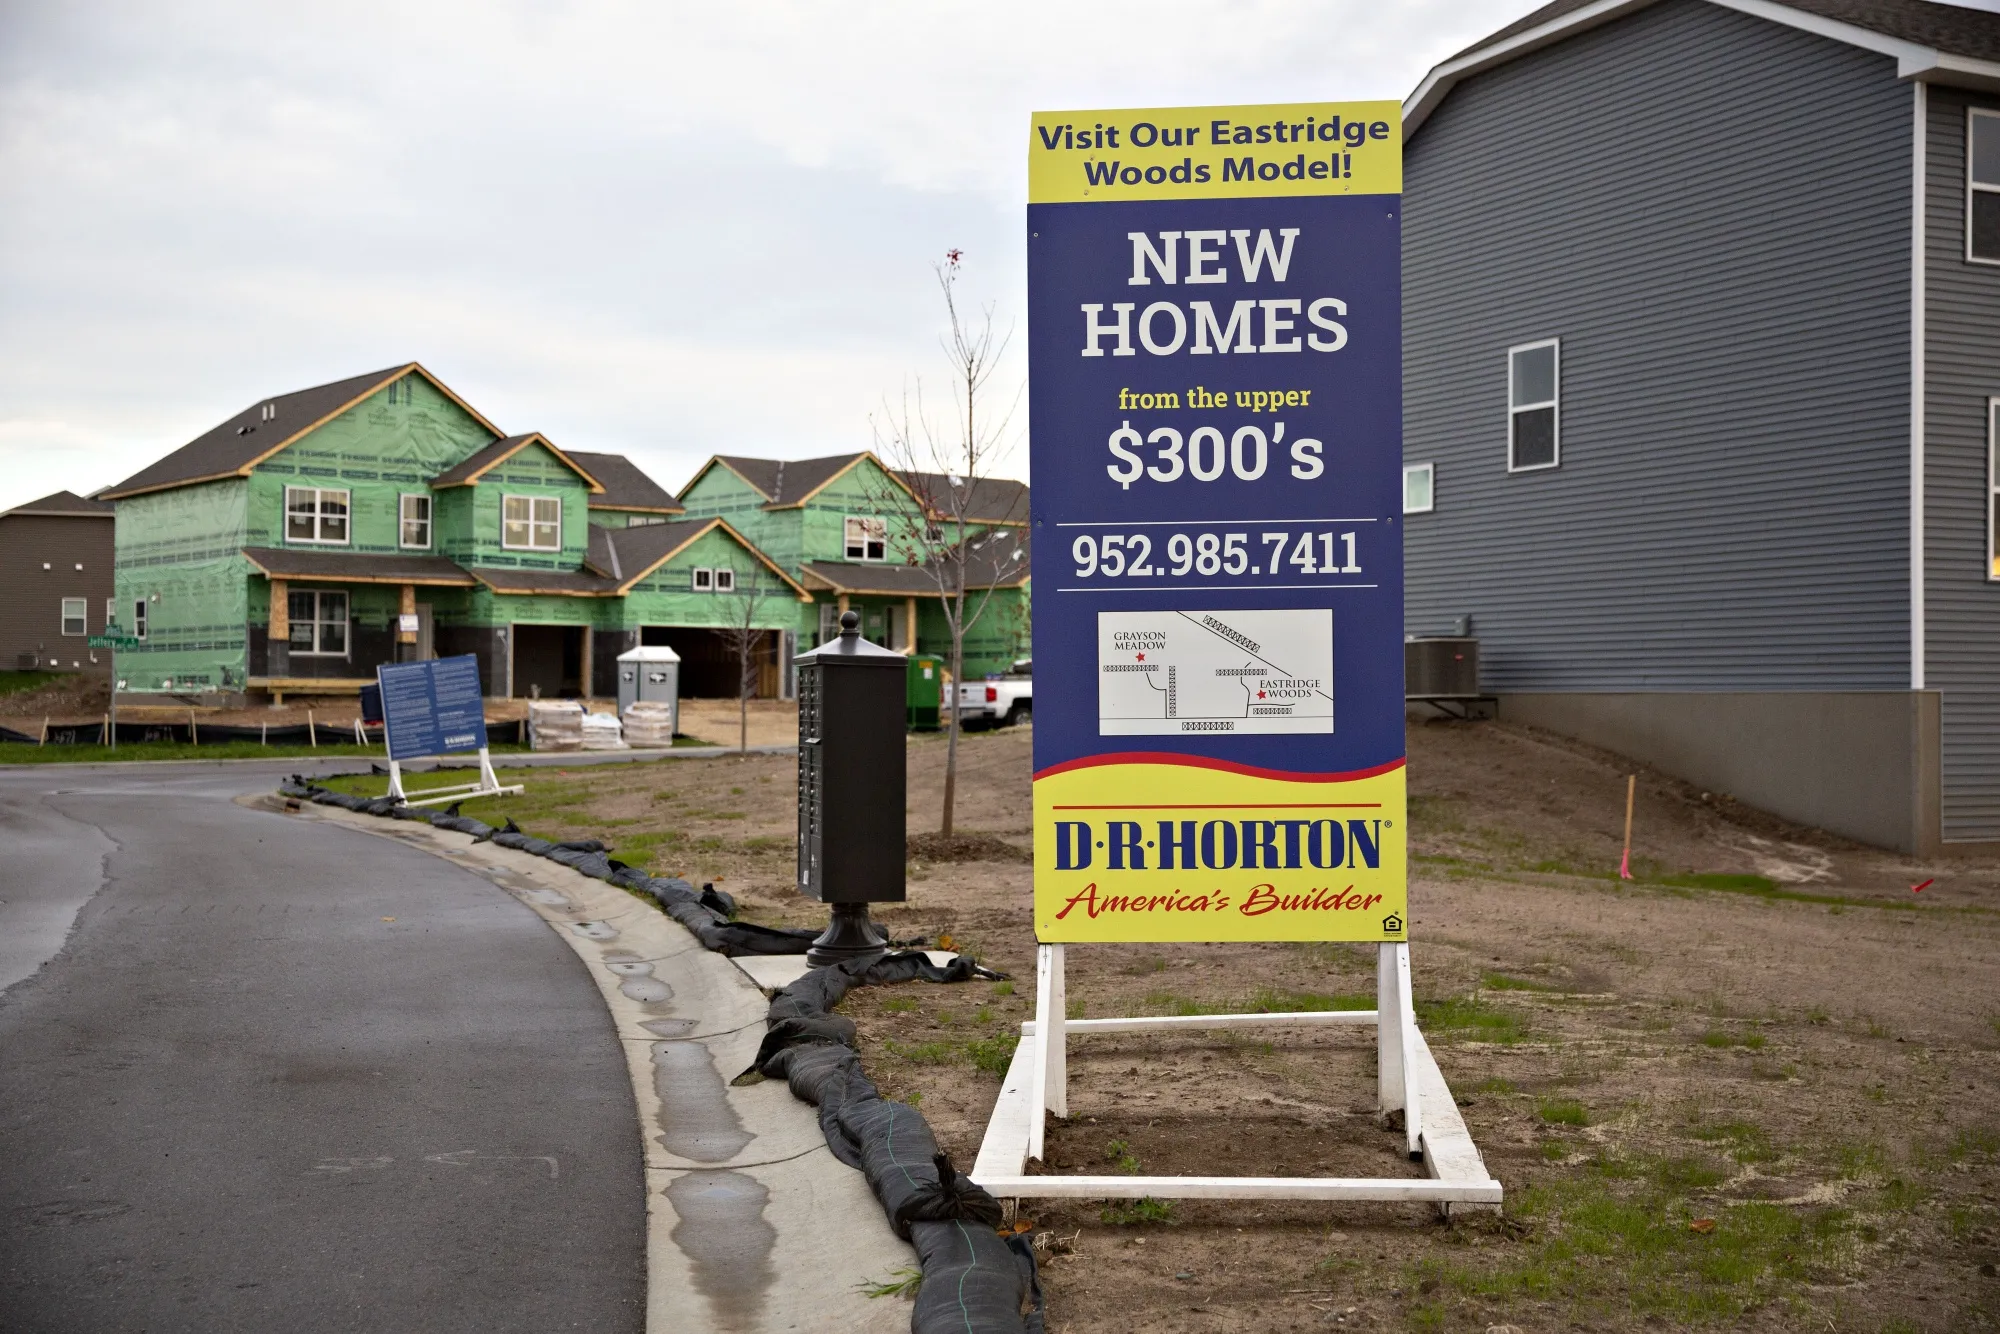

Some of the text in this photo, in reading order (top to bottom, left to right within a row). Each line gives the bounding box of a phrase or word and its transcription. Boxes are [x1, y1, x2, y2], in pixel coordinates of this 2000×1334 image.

[1037, 116, 1390, 150] Visit Our Eastridge
[1084, 153, 1352, 185] Woods Model!
[1128, 228, 1300, 285] NEW
[1081, 298, 1348, 356] HOMES
[1119, 386, 1311, 412] from the upper
[1107, 420, 1325, 490] $300's
[1072, 531, 1362, 578] 952.985.7411
[1113, 631, 1166, 641] GRAYSON
[1115, 641, 1166, 650] MEADOW
[1260, 679, 1321, 689] EASTRIDGE
[1268, 689, 1312, 699] WOODS
[1055, 882, 1383, 920] America's Builder
